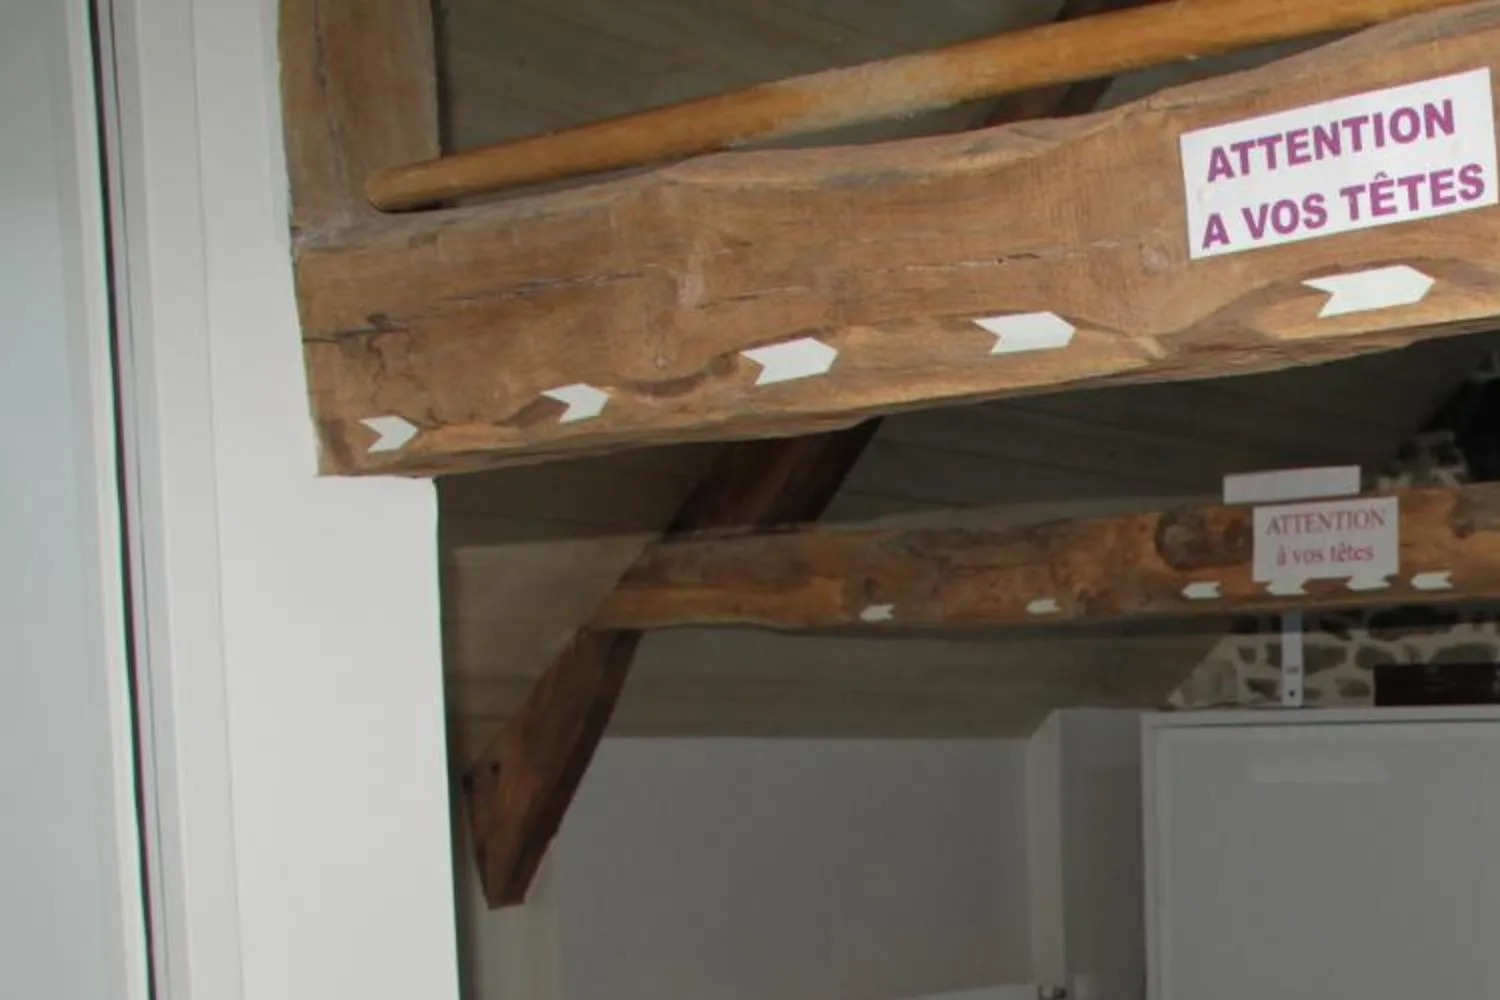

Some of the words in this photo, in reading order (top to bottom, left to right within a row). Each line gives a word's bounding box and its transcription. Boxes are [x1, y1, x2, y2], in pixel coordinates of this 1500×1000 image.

[1207, 99, 1456, 183] ATTENTION
[1202, 212, 1231, 250] A
[1241, 193, 1328, 241] VOS
[1340, 162, 1486, 222] TÊTES
[1266, 507, 1387, 537] ATTENTION
[1276, 544, 1287, 567] à
[1291, 547, 1325, 567] vos
[1330, 541, 1375, 563] têtes
